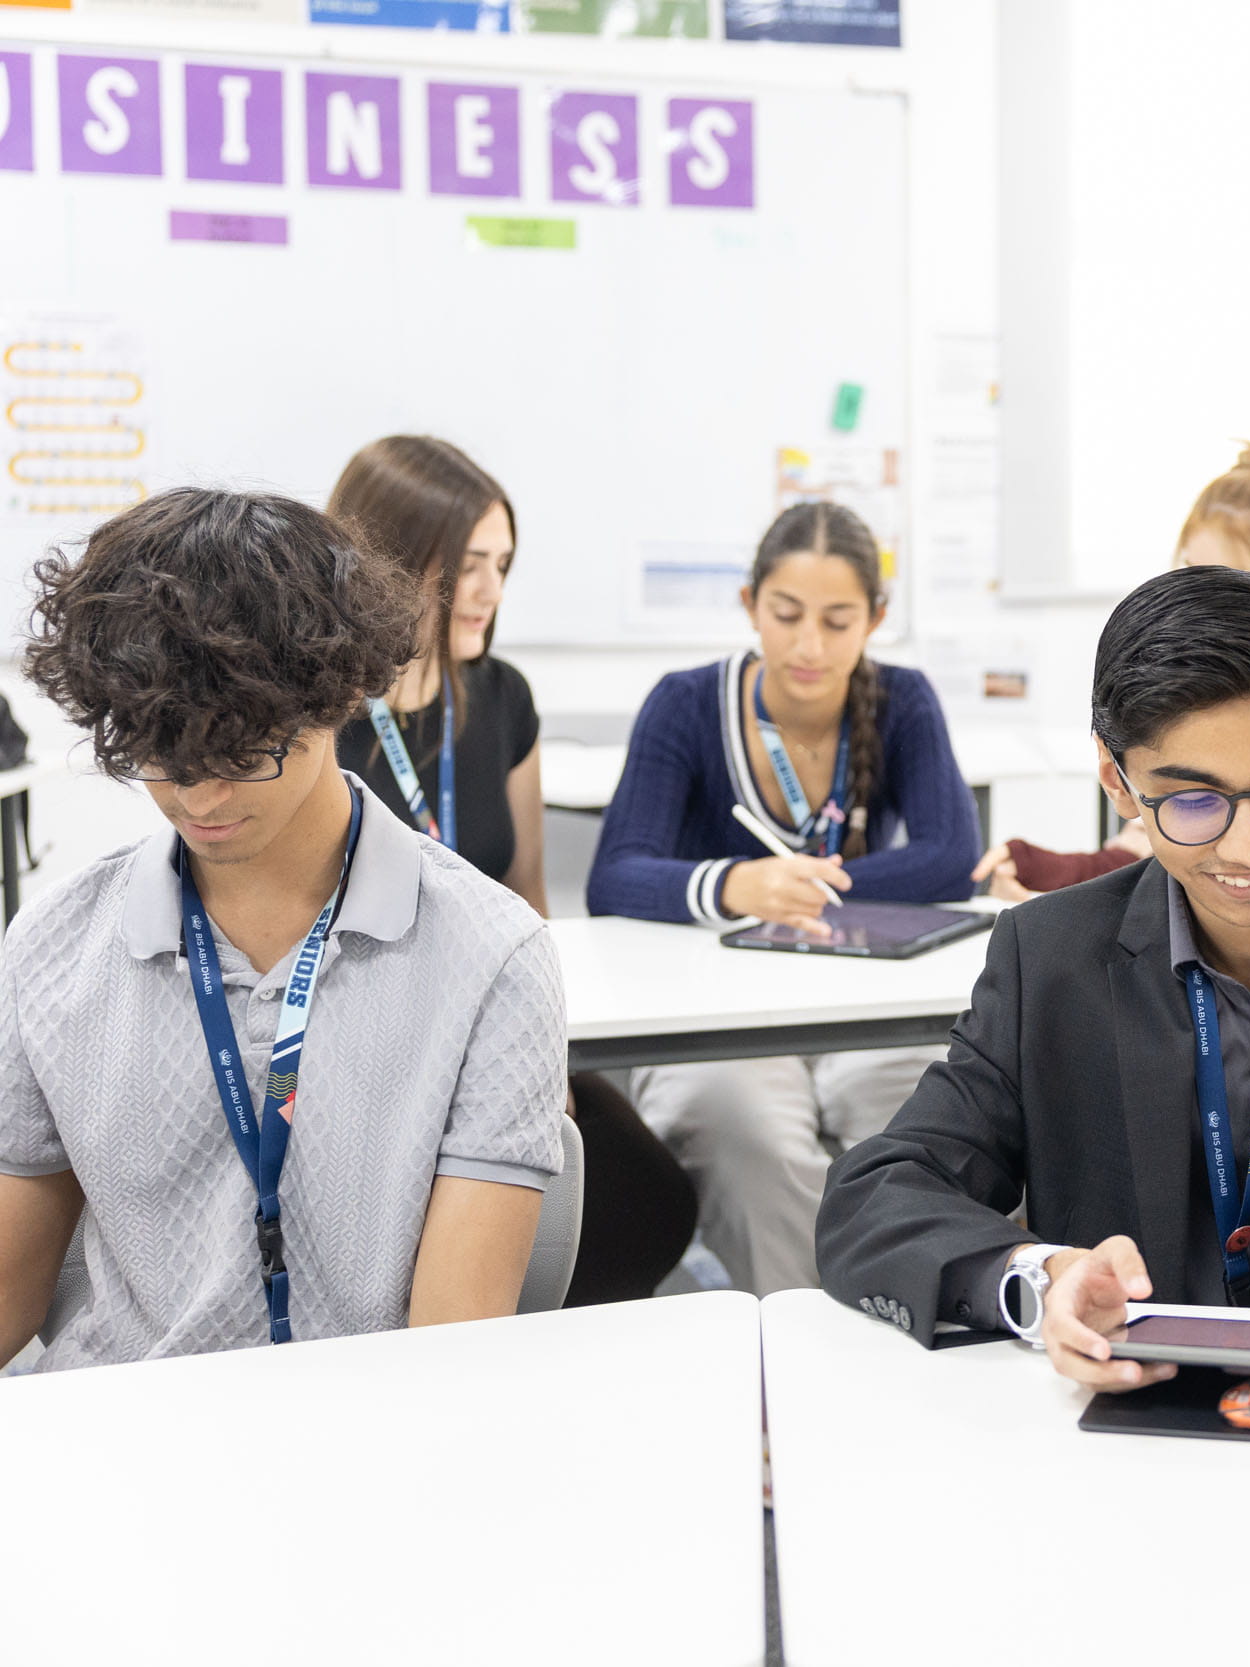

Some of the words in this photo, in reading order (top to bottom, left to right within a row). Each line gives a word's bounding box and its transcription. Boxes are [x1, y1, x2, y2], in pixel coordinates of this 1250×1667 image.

[0, 60, 738, 195] SINESS
[195, 933, 205, 946] BIS
[197, 947, 208, 965] ABU
[286, 907, 332, 1008] SENIORS
[201, 966, 213, 995] DHABI
[1195, 989, 1204, 1004] BIS
[1197, 1005, 1206, 1025] ABU
[1199, 1026, 1209, 1056] DHABI
[225, 1069, 236, 1085] BIS
[228, 1085, 241, 1105] ABU
[235, 1106, 249, 1135] DHABI
[1211, 1131, 1221, 1146] BIS
[1214, 1147, 1224, 1167] ABU
[1217, 1168, 1229, 1197] DHABI
